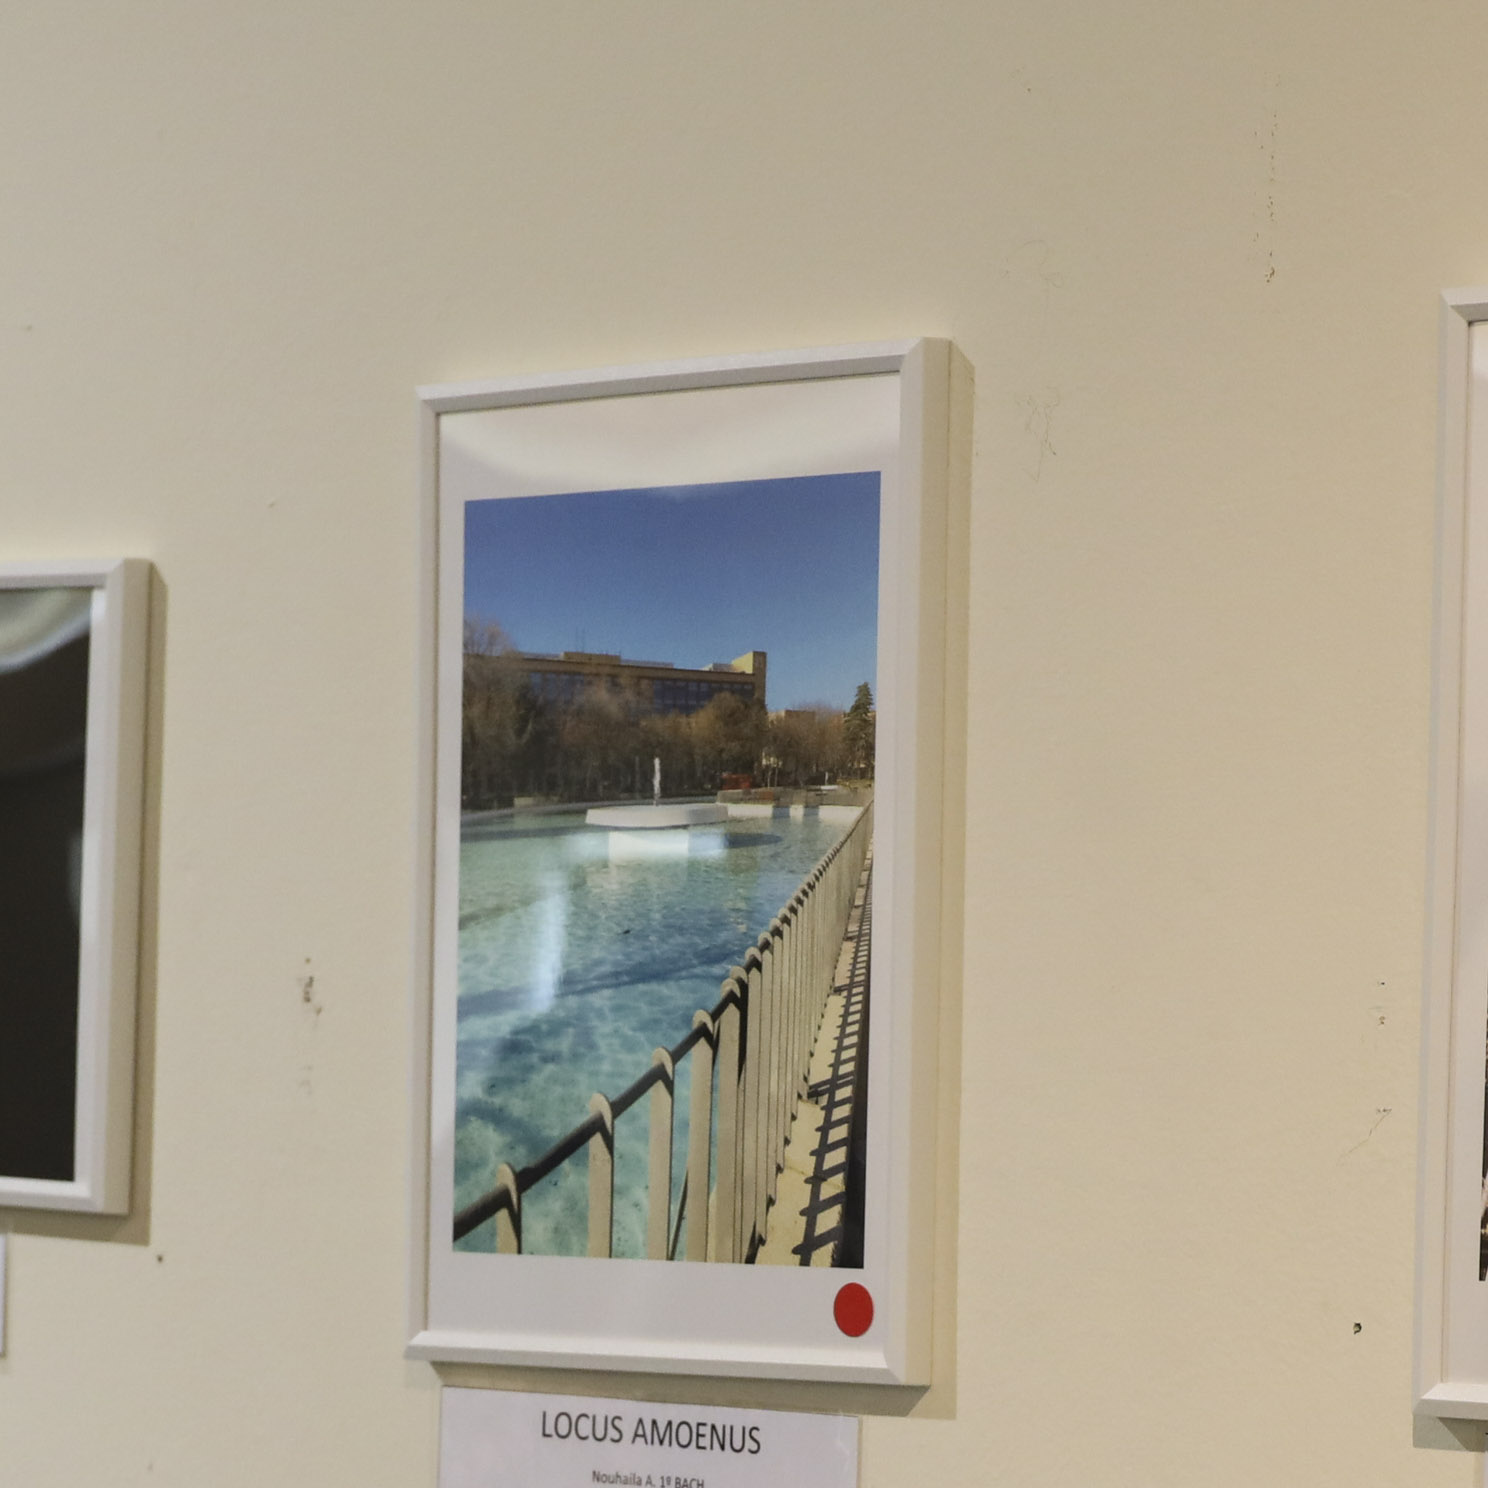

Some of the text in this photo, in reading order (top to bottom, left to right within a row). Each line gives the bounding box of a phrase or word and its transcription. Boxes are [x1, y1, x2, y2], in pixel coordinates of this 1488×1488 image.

[541, 1409, 762, 1455] LOCUS AMOENUS
[591, 1469, 643, 1488] Nouhaila
[645, 1474, 657, 1488] A.
